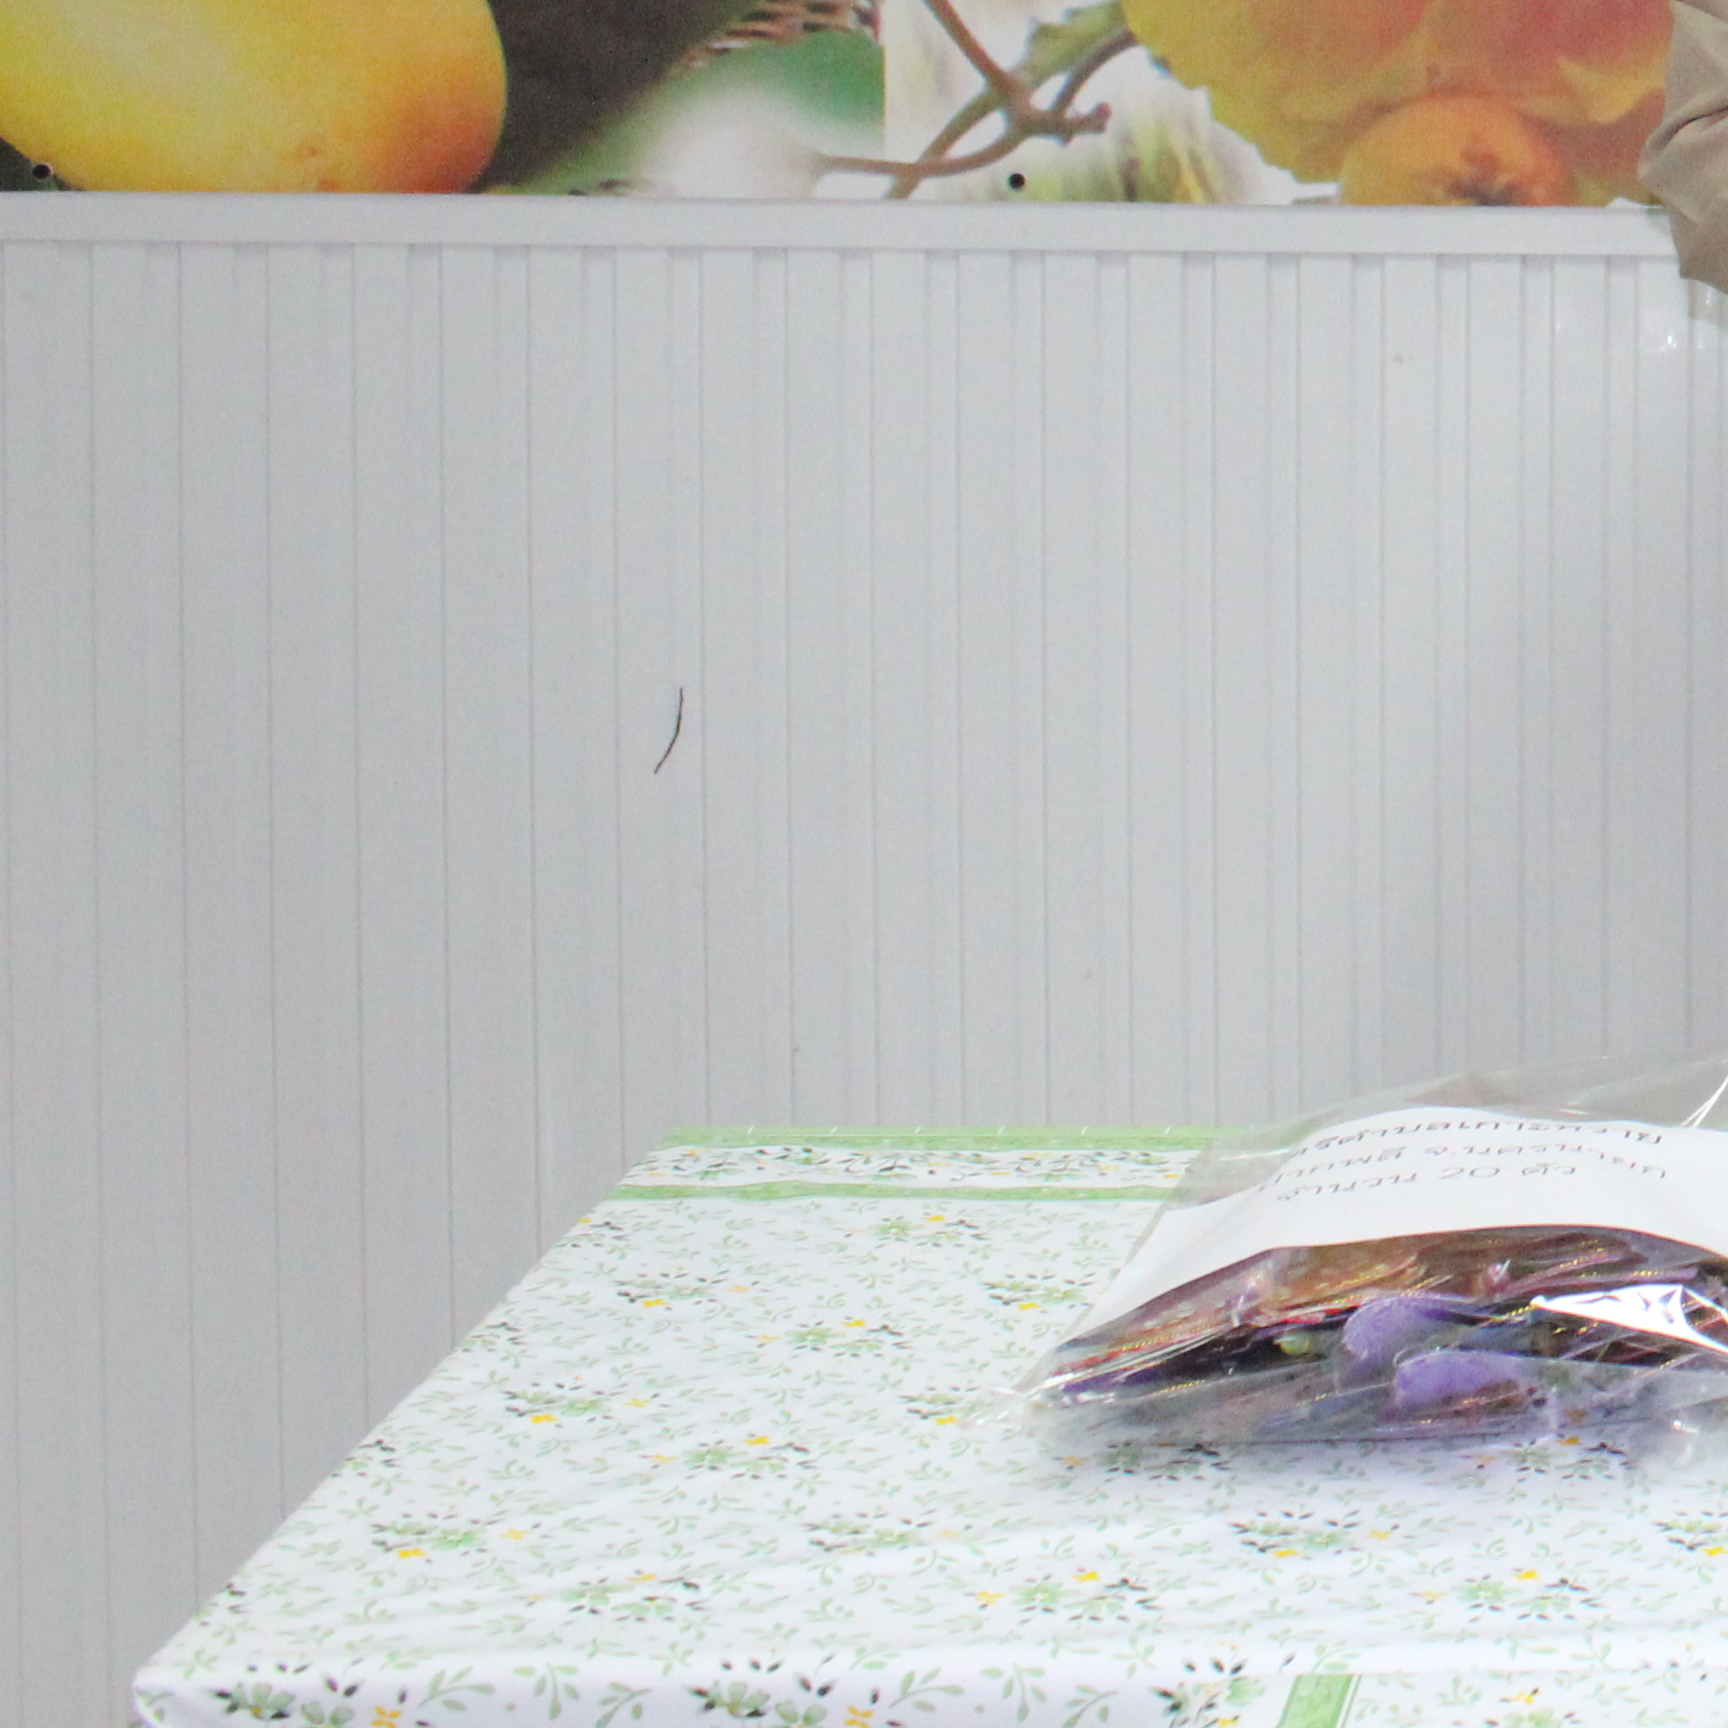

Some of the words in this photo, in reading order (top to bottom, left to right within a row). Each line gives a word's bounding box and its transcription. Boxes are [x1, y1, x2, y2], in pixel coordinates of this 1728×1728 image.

[1276, 1172, 1417, 1201] จำนวน
[1439, 1166, 1501, 1181] 20
[1521, 1161, 1577, 1177] ตัว
